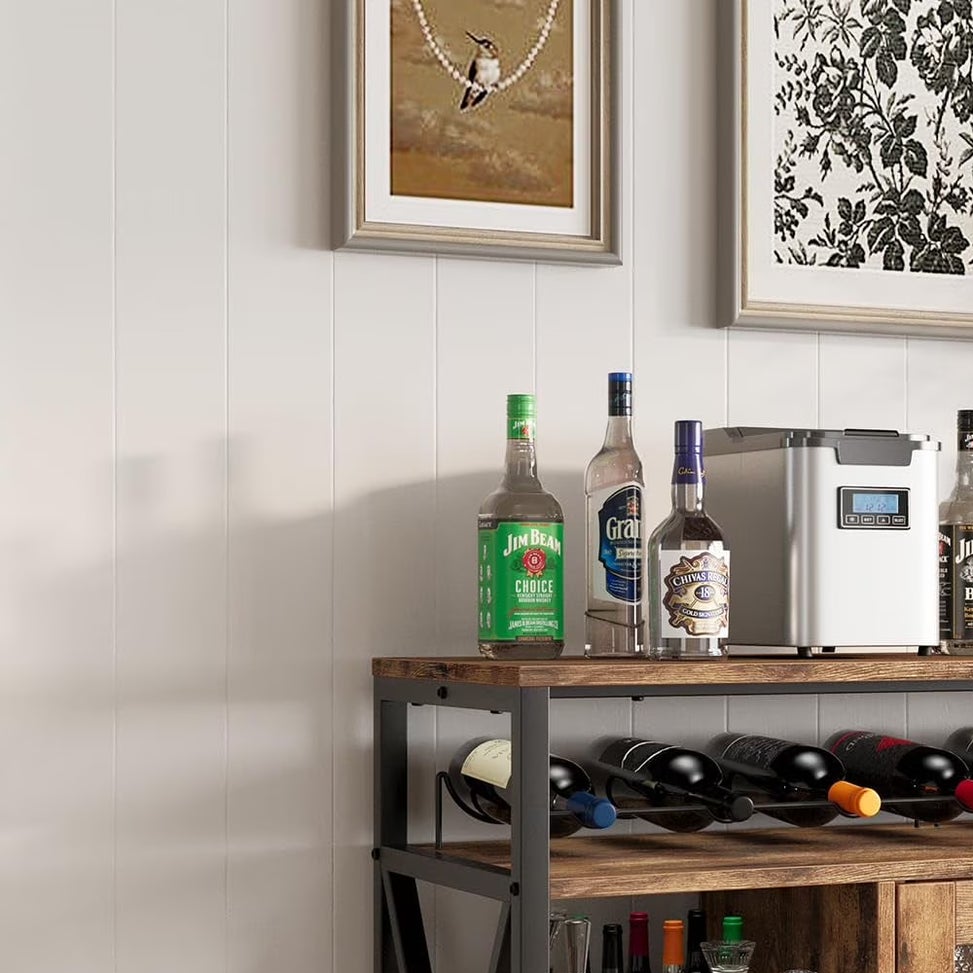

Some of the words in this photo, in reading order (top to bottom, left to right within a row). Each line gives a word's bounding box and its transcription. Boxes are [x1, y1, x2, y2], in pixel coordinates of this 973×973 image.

[503, 533, 529, 557] JIM
[530, 528, 561, 557] BEAM
[515, 579, 553, 593] CHOICE
[673, 571, 707, 587] CHIVAS
[700, 586, 710, 599] 18
